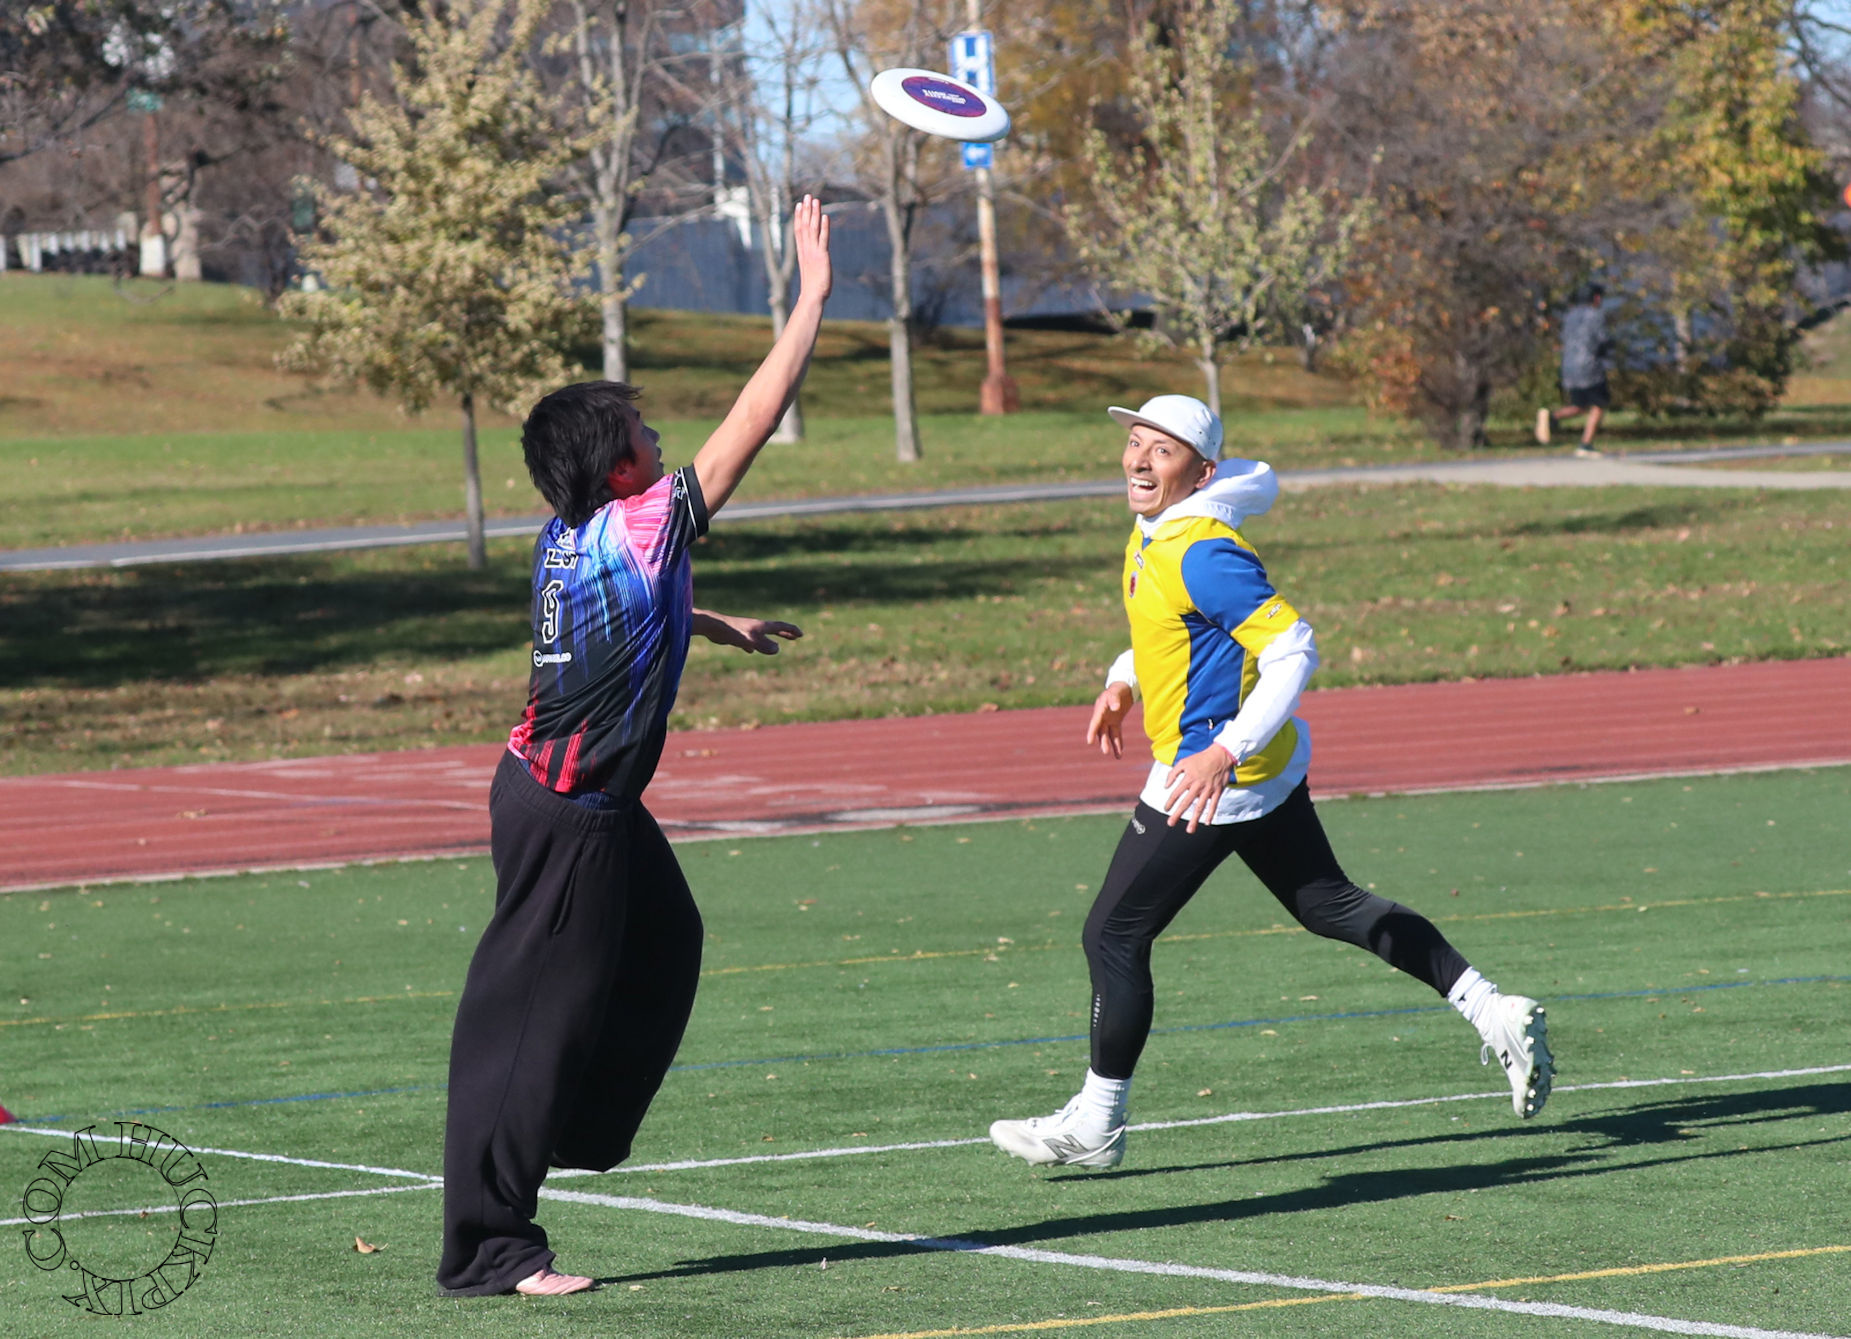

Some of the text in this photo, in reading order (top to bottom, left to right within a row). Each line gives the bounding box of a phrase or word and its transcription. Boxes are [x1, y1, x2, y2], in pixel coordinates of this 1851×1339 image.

[953, 34, 989, 95] H
[541, 579, 564, 644] 9
[1042, 1134, 1089, 1159] N
